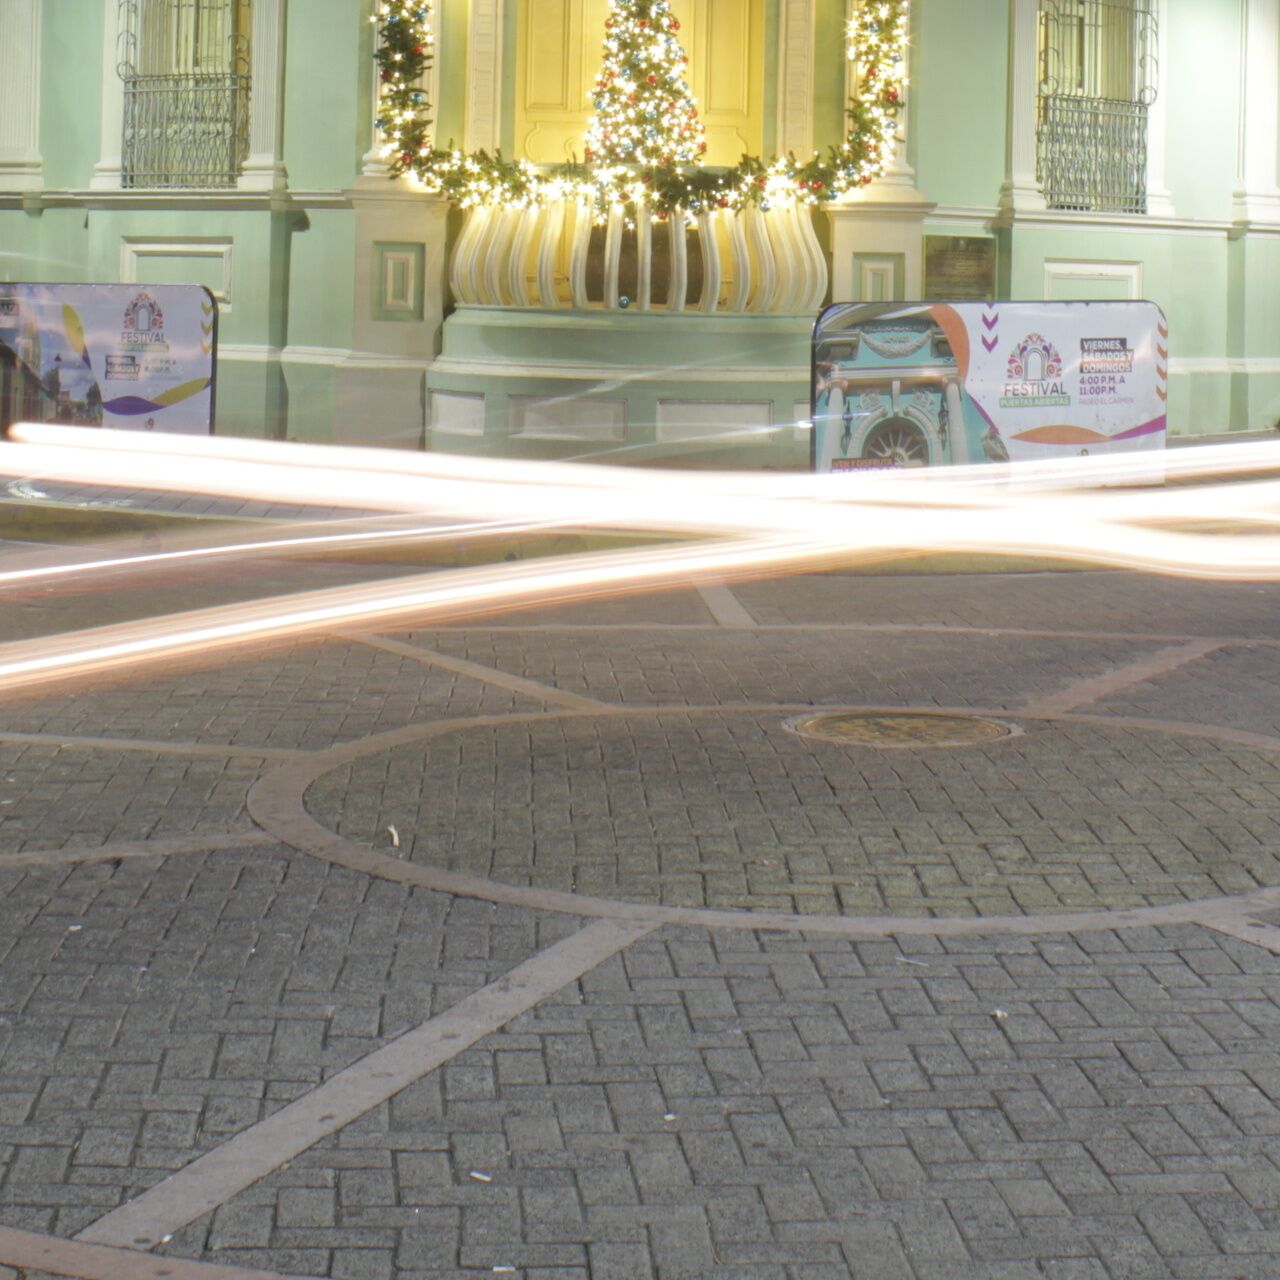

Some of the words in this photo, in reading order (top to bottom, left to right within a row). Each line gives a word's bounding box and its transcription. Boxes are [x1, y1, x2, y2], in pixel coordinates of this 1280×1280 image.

[121, 331, 166, 344] FESTIVAL
[1083, 362, 1130, 373] DOMINGOS
[1004, 382, 1067, 396] FESTIVAL
